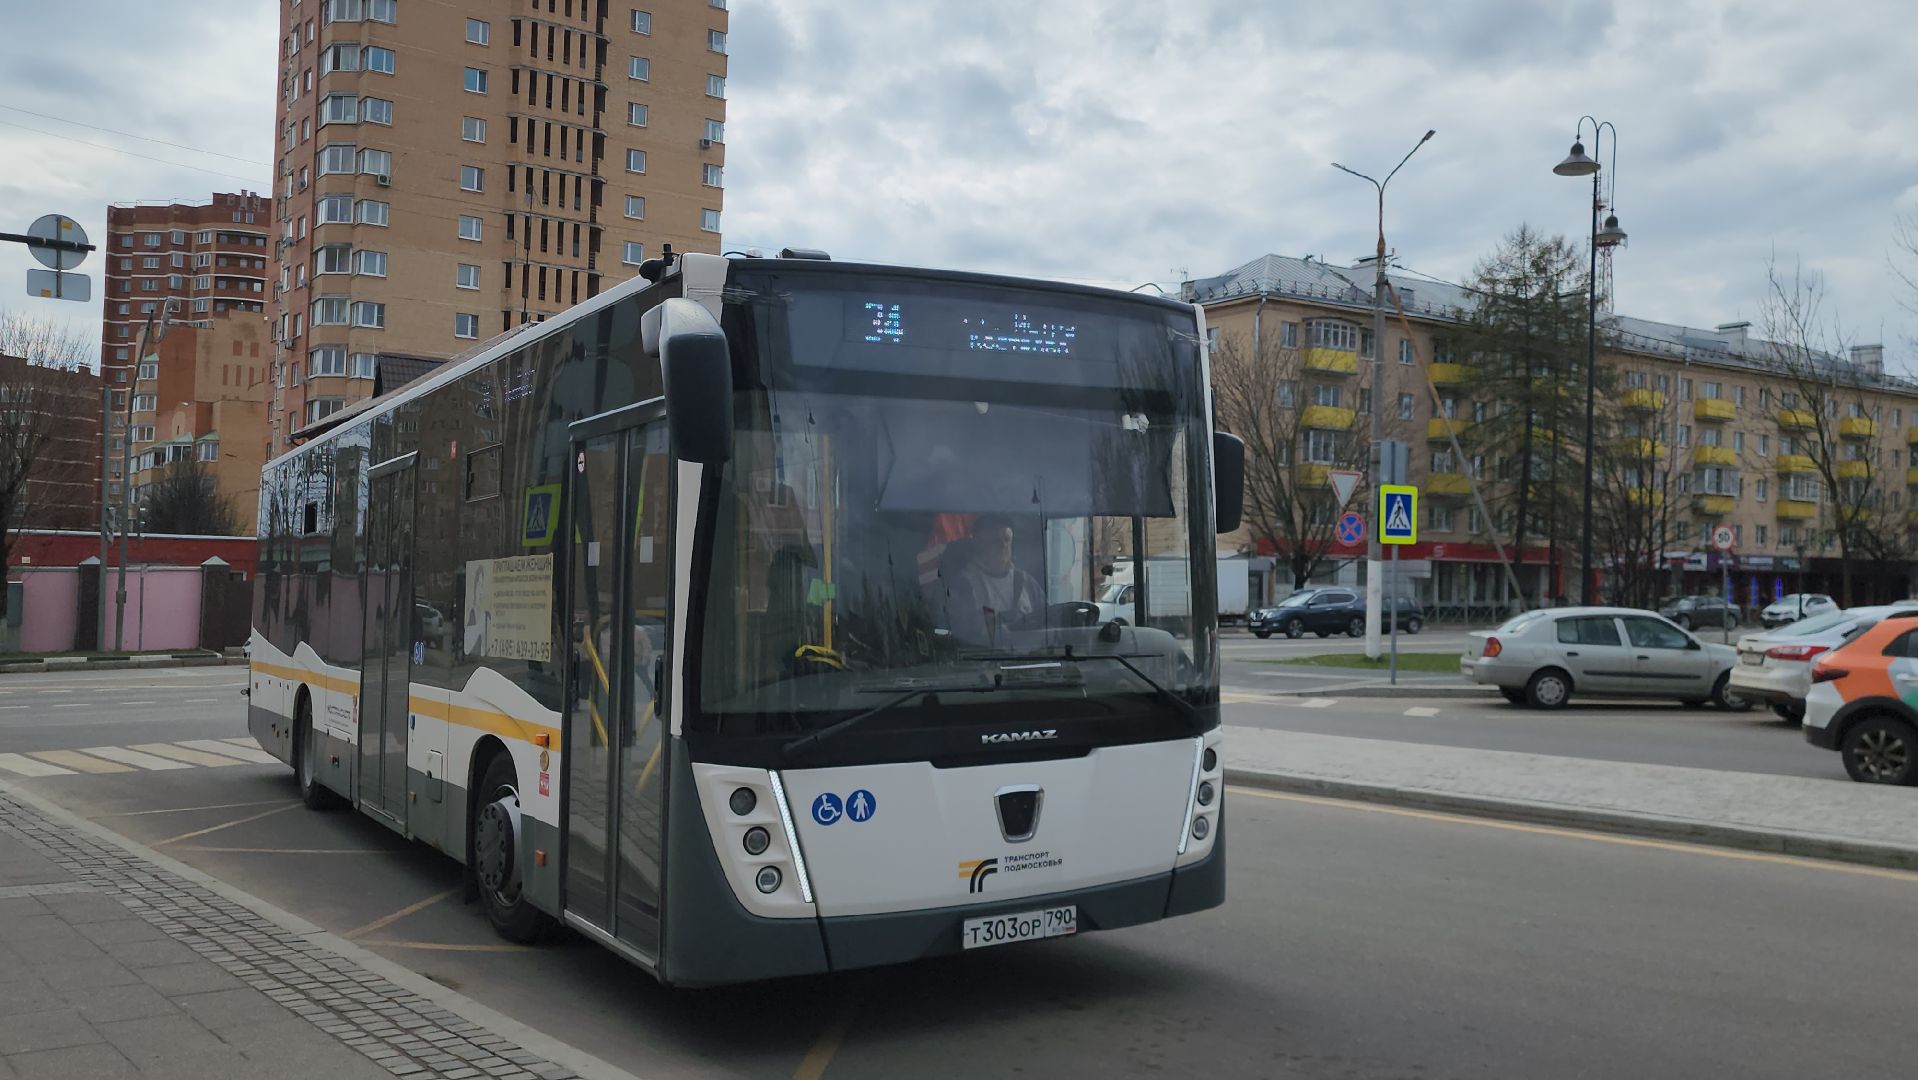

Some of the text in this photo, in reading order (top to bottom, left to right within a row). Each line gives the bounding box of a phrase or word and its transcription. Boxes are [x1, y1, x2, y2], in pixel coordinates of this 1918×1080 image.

[981, 729, 1059, 744] KAMAZ
[1004, 851, 1050, 864] ТРАНСПОРТ
[1004, 858, 1063, 873] ПОДМОСКОВЬЯ
[970, 908, 1073, 944] Т303ОР 790
